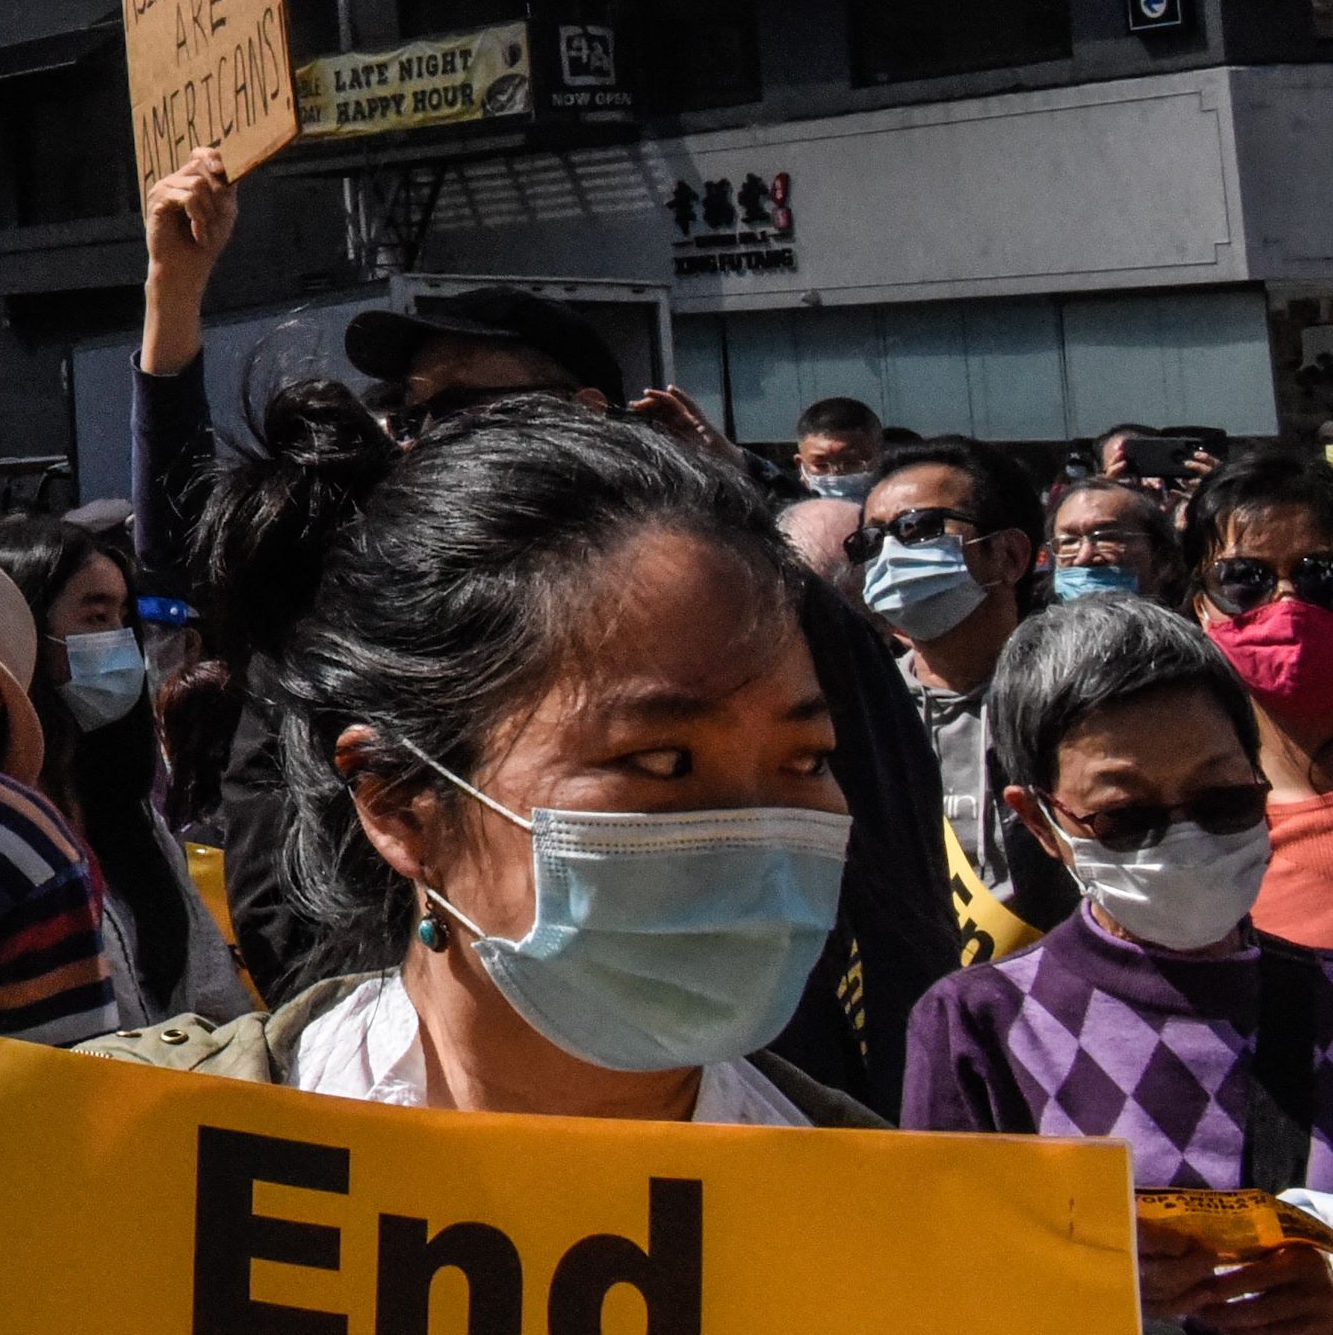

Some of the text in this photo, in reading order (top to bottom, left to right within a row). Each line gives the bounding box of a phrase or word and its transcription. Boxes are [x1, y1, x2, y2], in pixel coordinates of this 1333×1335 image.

[334, 63, 389, 93] LATE
[398, 49, 472, 83] NIGHT
[335, 92, 406, 125] HAPPY
[412, 83, 475, 114] HOUR
[551, 91, 633, 106] NOW OPEN
[190, 1126, 705, 1335] End
